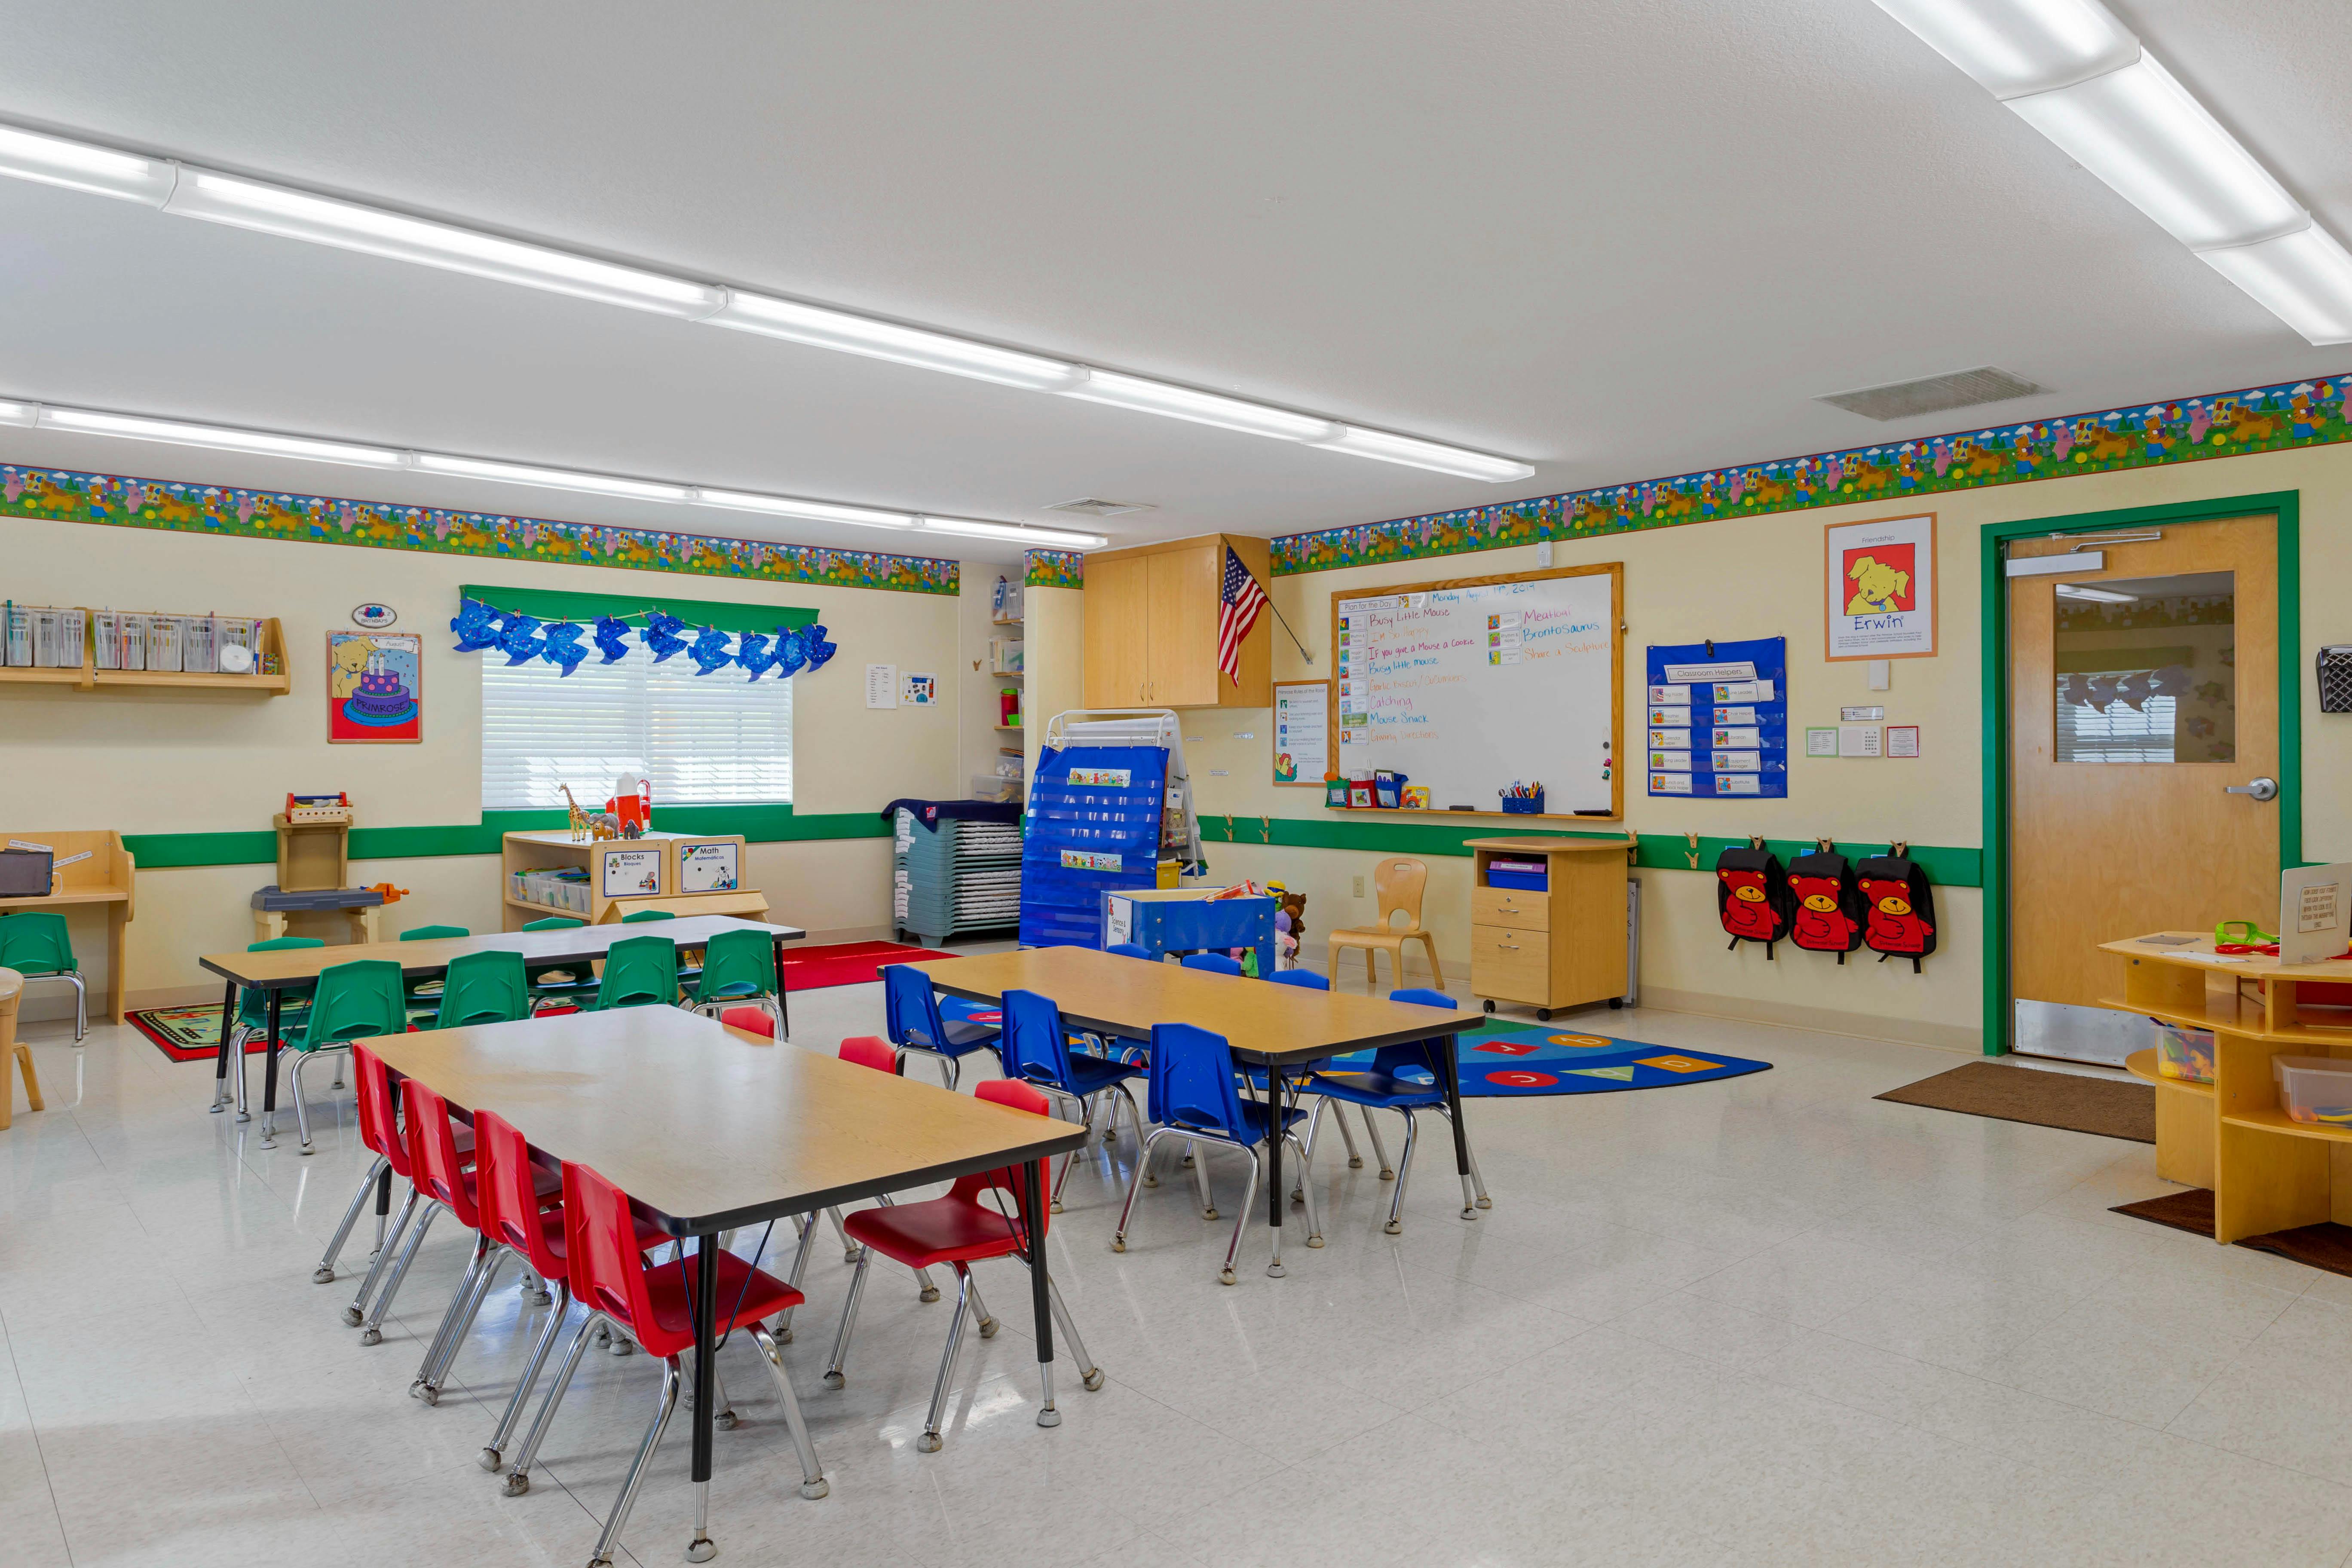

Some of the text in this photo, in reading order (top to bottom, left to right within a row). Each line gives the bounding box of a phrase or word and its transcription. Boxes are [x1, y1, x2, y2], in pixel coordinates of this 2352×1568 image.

[1862, 535, 1895, 543] Friendship
[1433, 592, 1460, 603] Monday
[1513, 583, 1535, 593] 2019
[1369, 614, 1393, 628] Busy
[1397, 611, 1420, 622] Little
[1423, 609, 1450, 618] Mouse
[1524, 604, 1573, 624] Meatloaf
[1403, 626, 1430, 640] Happy
[1382, 649, 1393, 660] you
[1395, 647, 1409, 658] give
[1418, 642, 1440, 652] Mouse
[1452, 639, 1475, 647] Cookie
[1524, 648, 1550, 662] Share
[1565, 640, 1609, 654] Sculpture
[1369, 661, 1391, 675] Busy
[1393, 659, 1411, 669] little
[1414, 656, 1439, 665] mouse
[1677, 668, 1743, 677] Classroom Helpers
[1369, 679, 1390, 692] Garlic
[356, 698, 406, 713] PRIMROSE
[1370, 695, 1413, 710] Catching
[1370, 711, 1429, 725] Mouse Snack
[1401, 730, 1439, 740] Directions
[1112, 916, 1123, 927] Science
[1113, 924, 1124, 935] Sensory
[1592, 1069, 1630, 1078] b
